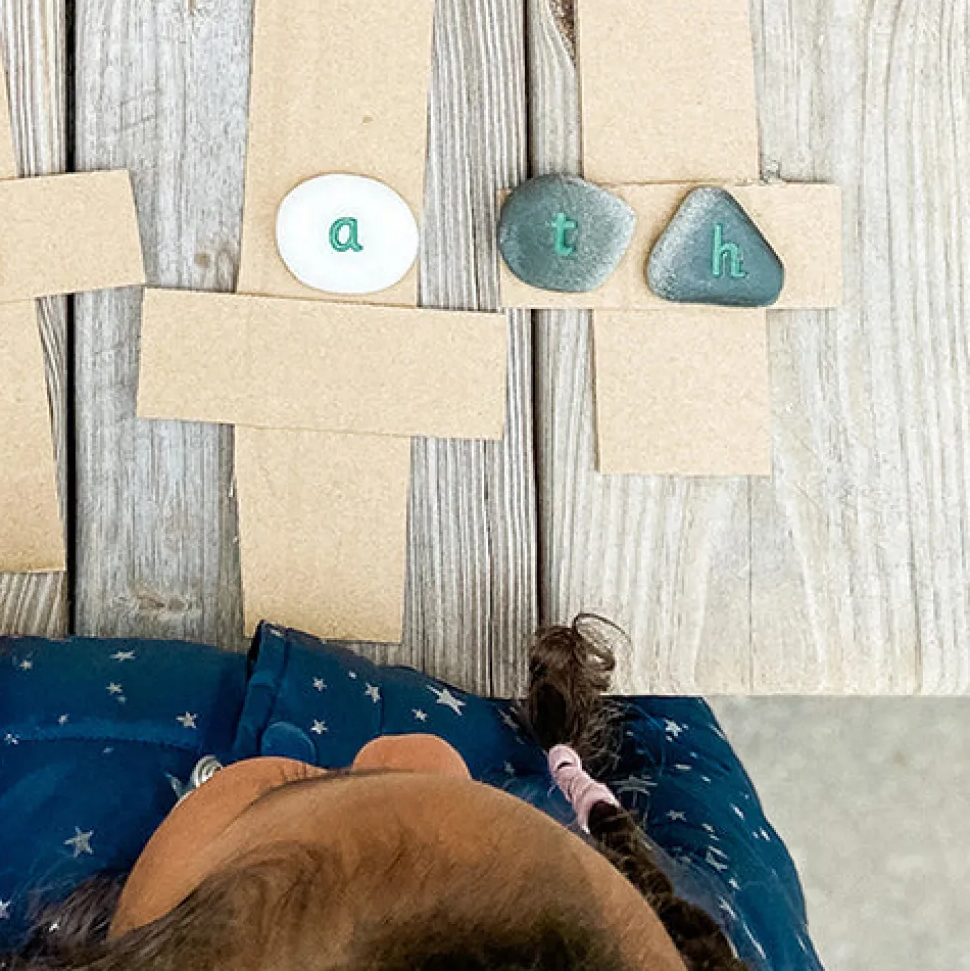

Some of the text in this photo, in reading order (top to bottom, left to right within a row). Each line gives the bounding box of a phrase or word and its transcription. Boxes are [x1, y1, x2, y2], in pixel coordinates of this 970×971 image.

[327, 215, 365, 255] a
[548, 211, 580, 259] t
[710, 222, 746, 280] h
